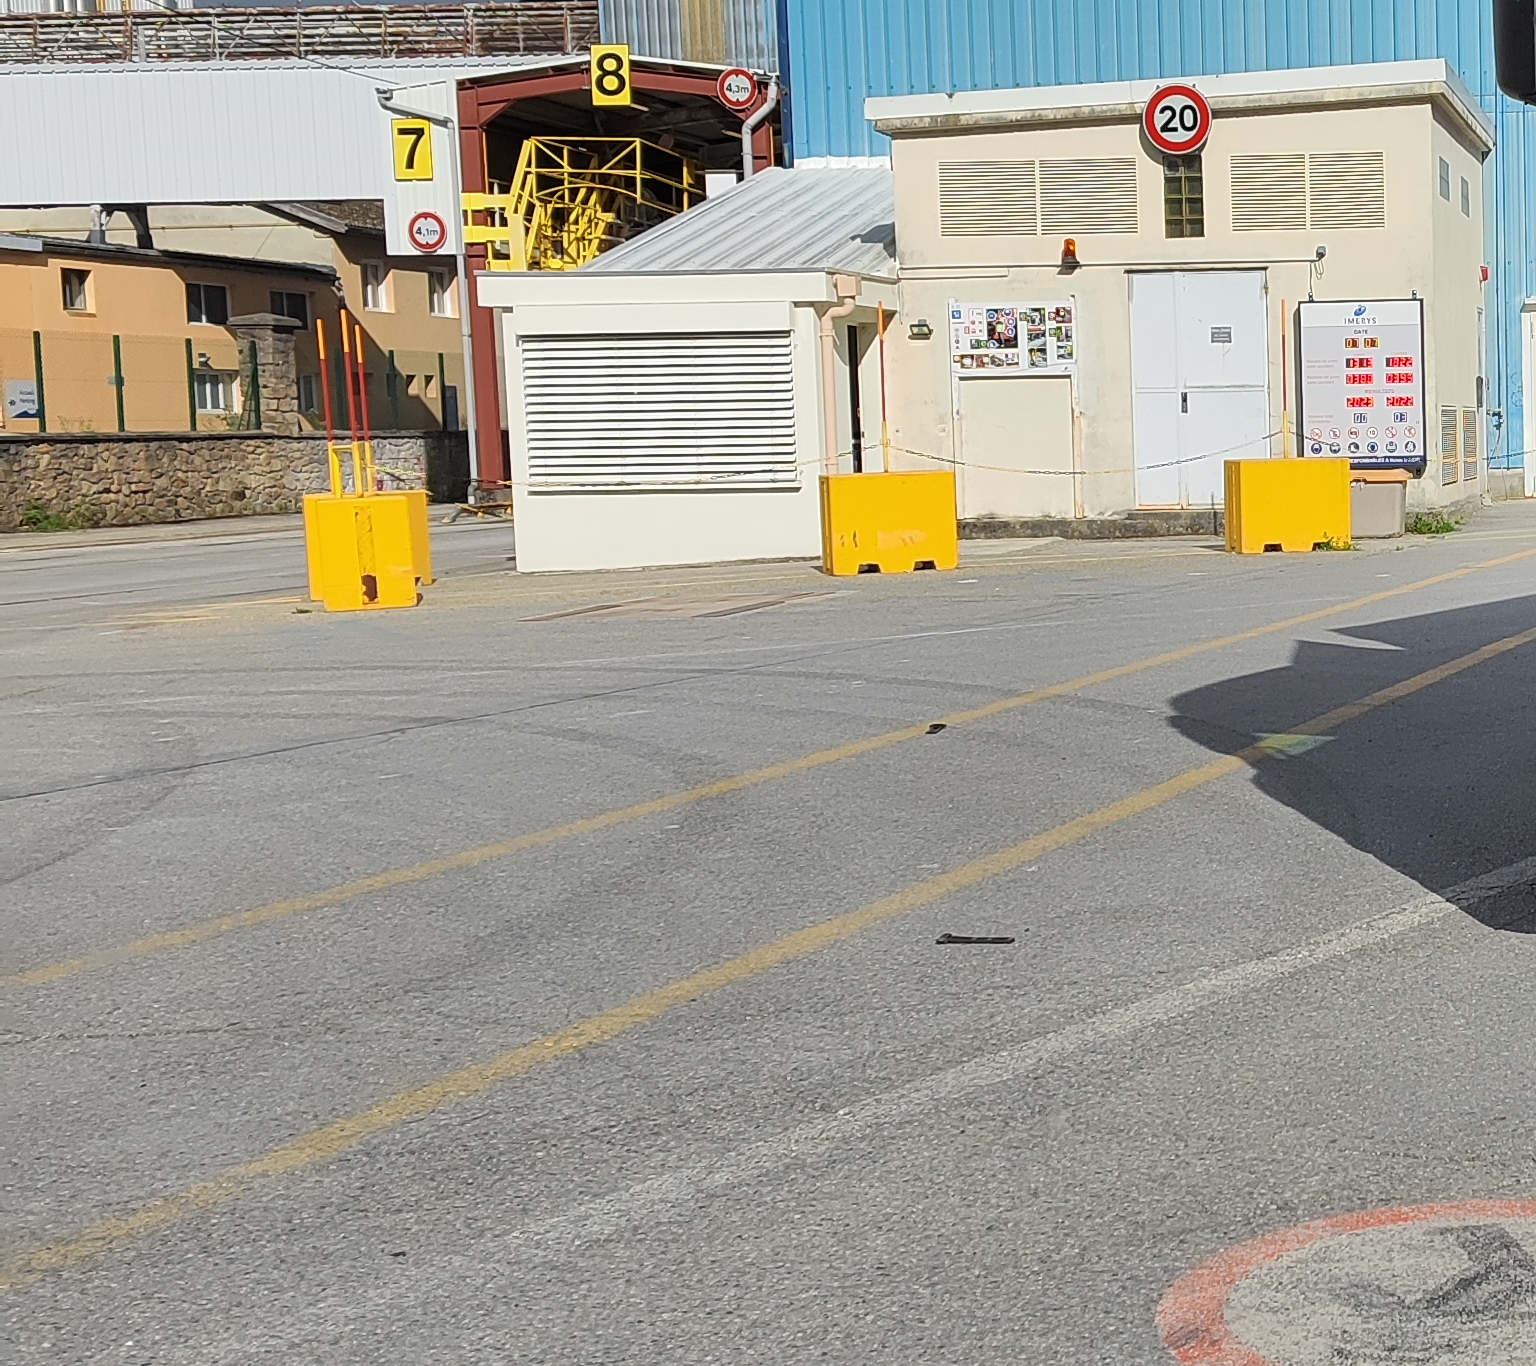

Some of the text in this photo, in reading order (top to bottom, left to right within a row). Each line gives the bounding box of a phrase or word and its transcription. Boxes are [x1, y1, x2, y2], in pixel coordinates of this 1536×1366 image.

[595, 52, 626, 96] 8
[1158, 104, 1199, 134] 20
[396, 127, 426, 170] 7
